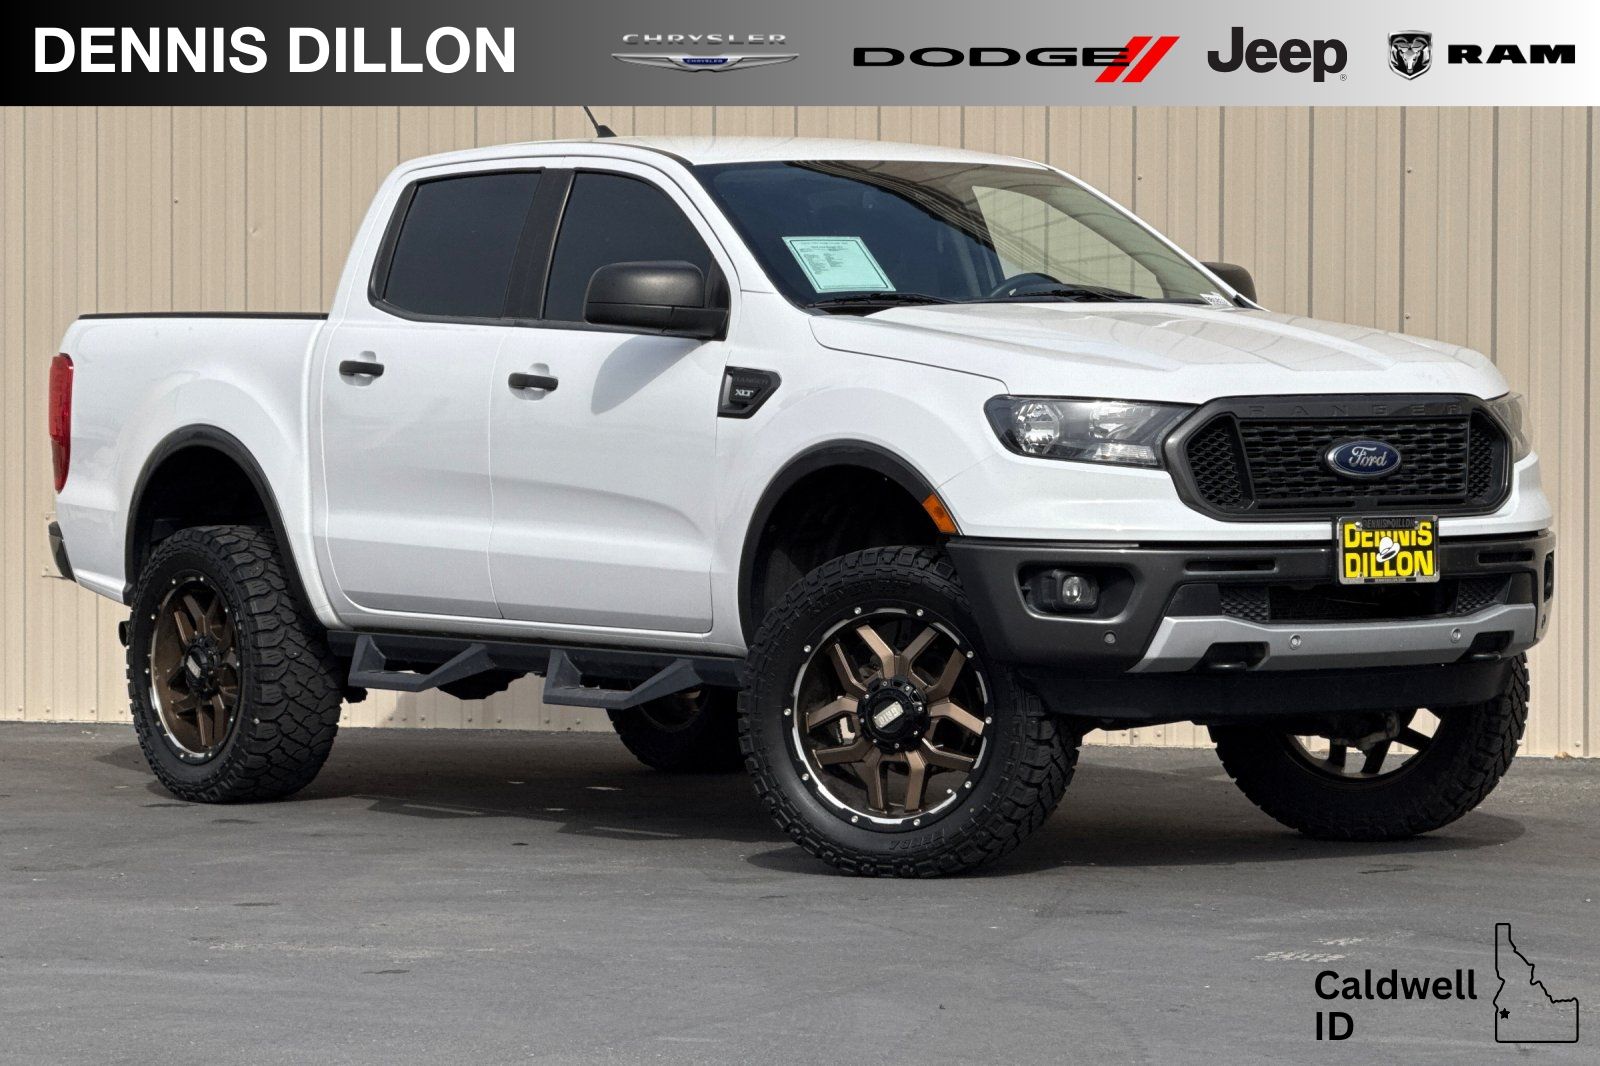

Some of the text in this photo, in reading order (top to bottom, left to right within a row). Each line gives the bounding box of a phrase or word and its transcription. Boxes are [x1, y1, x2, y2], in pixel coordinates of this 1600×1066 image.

[734, 388, 754, 397] XLT
[1248, 403, 1464, 417] RANGER
[1349, 446, 1387, 468] Ford
[1345, 550, 1434, 578] DILLON
